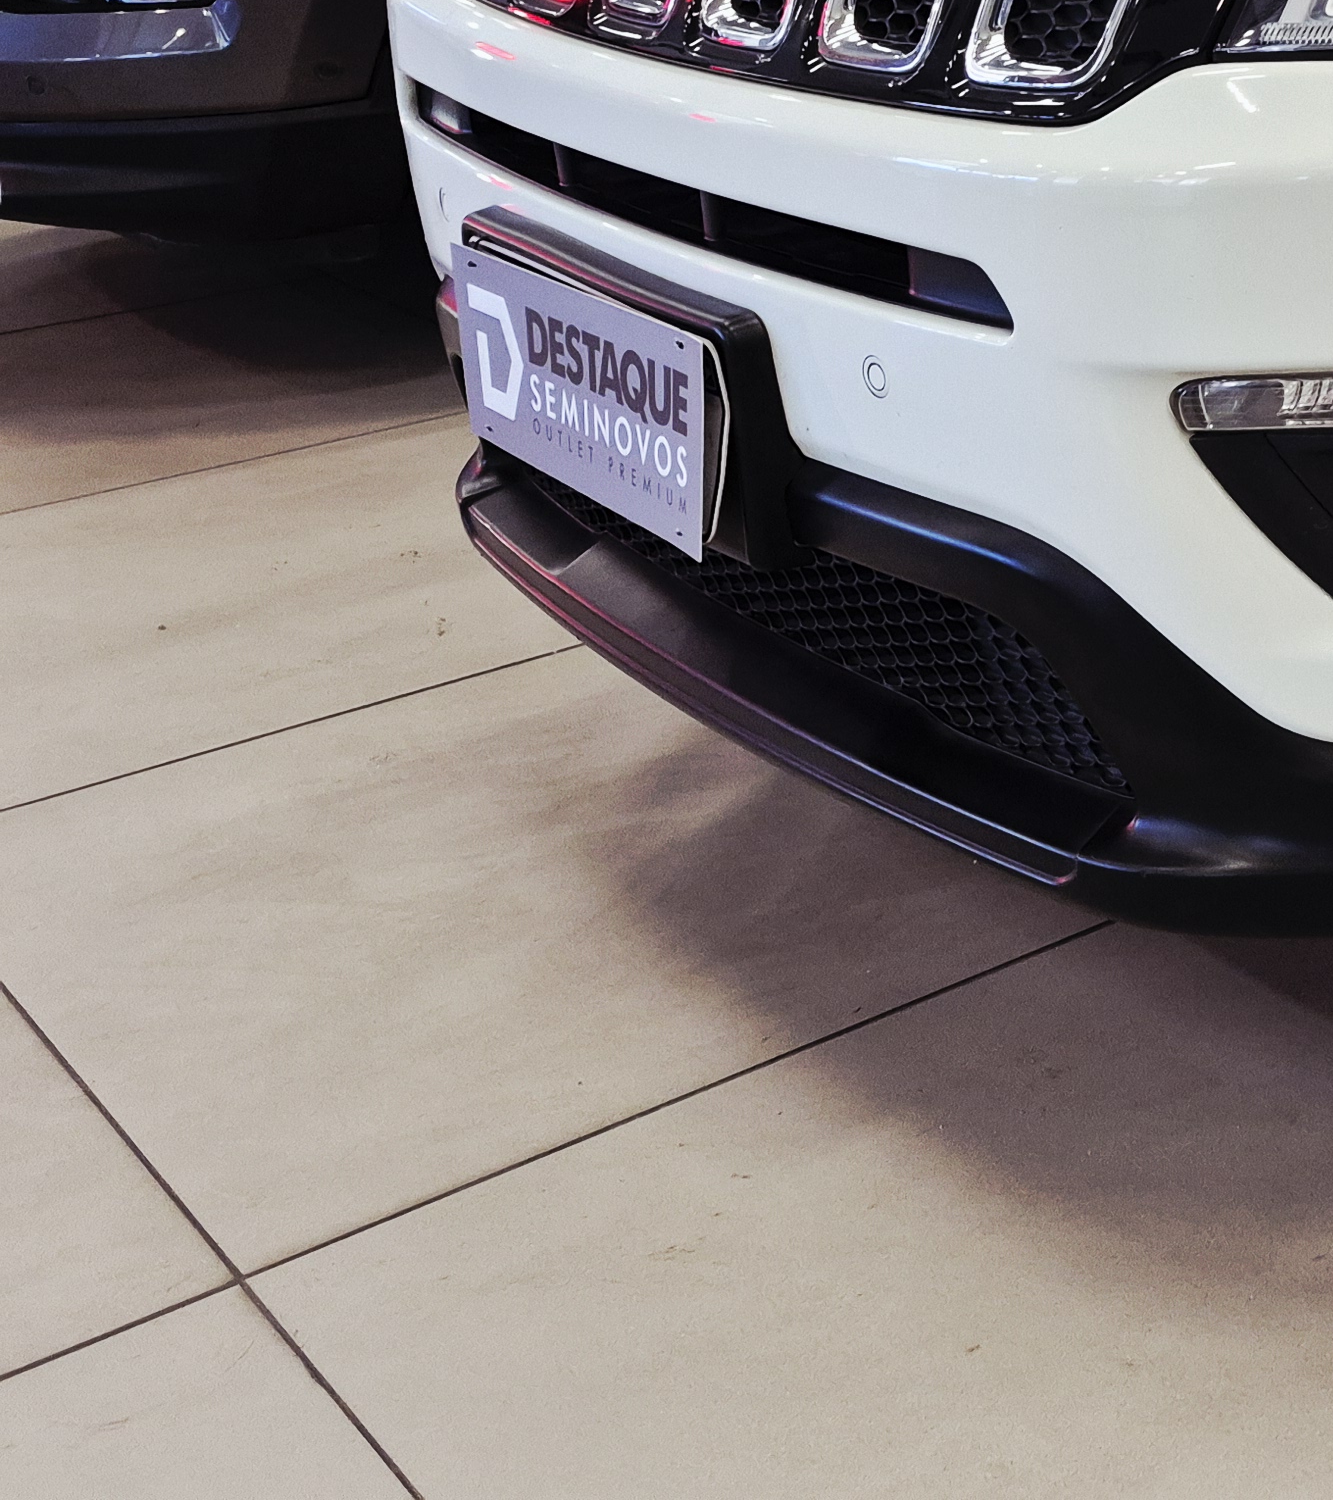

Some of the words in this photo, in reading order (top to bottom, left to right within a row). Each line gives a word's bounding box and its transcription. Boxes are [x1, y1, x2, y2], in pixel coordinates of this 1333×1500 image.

[525, 306, 688, 437] DESTAQUE
[529, 374, 688, 487] SEMINOVOS
[532, 417, 594, 463] OUTLET
[608, 455, 687, 515] PREMIUM
